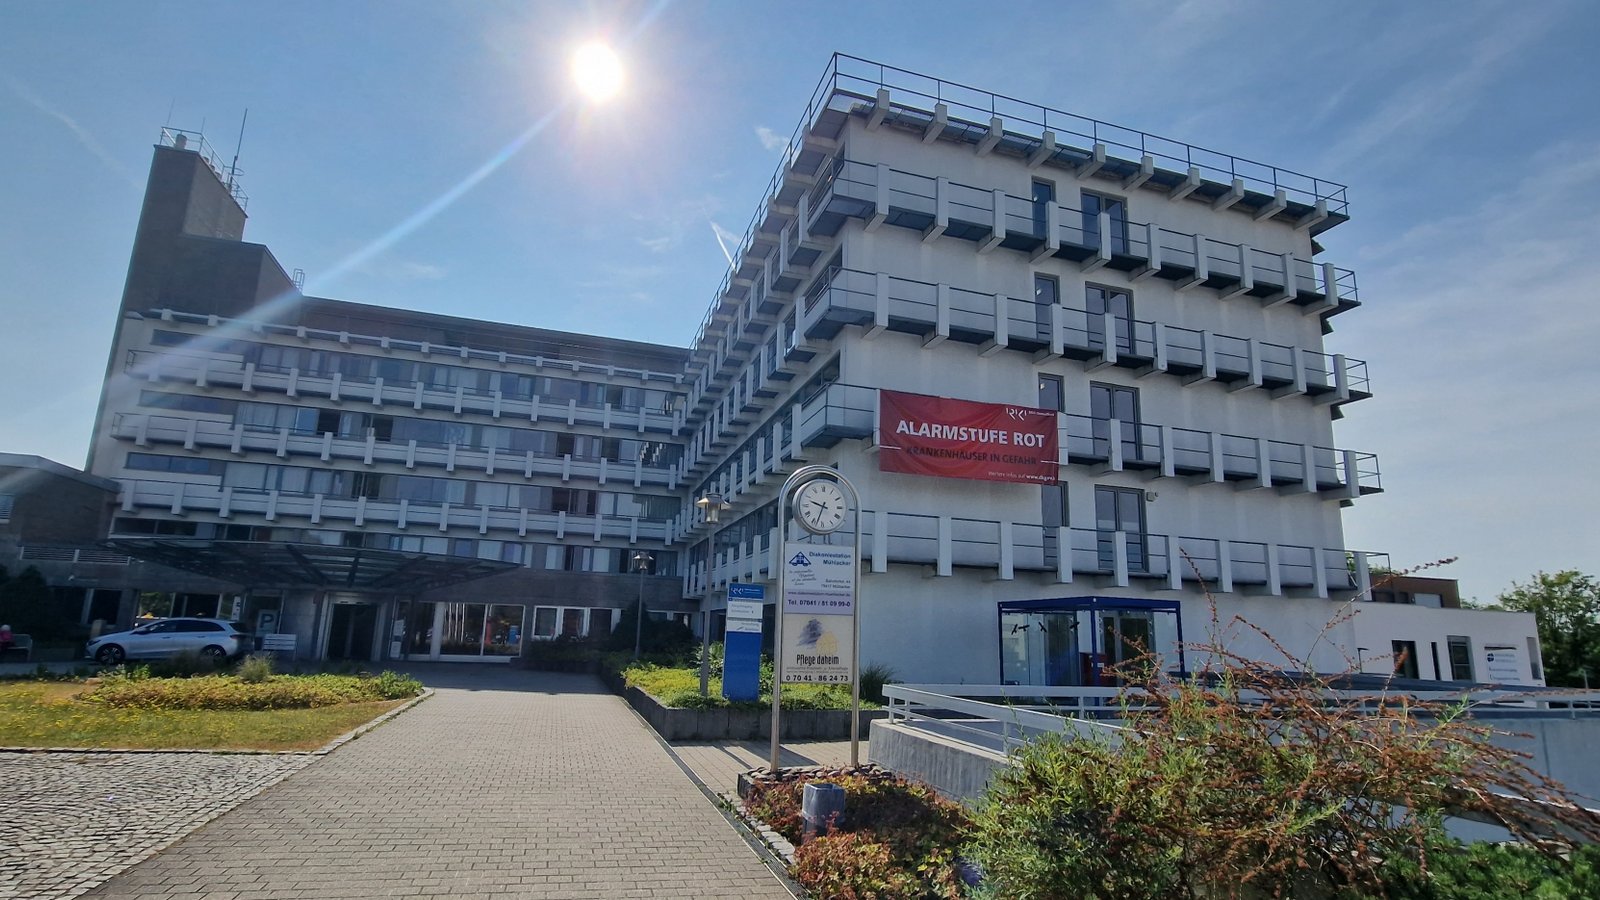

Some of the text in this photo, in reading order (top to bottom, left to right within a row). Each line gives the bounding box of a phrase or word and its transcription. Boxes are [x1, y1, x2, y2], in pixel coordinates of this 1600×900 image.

[896, 419, 1045, 448] ALARMSTUFE ROT
[990, 454, 1000, 463] IN
[1002, 455, 1036, 465] GEFAHR
[809, 551, 851, 559] Diakoniestation
[260, 613, 274, 628] P
[796, 654, 840, 667] Pflege daheim
